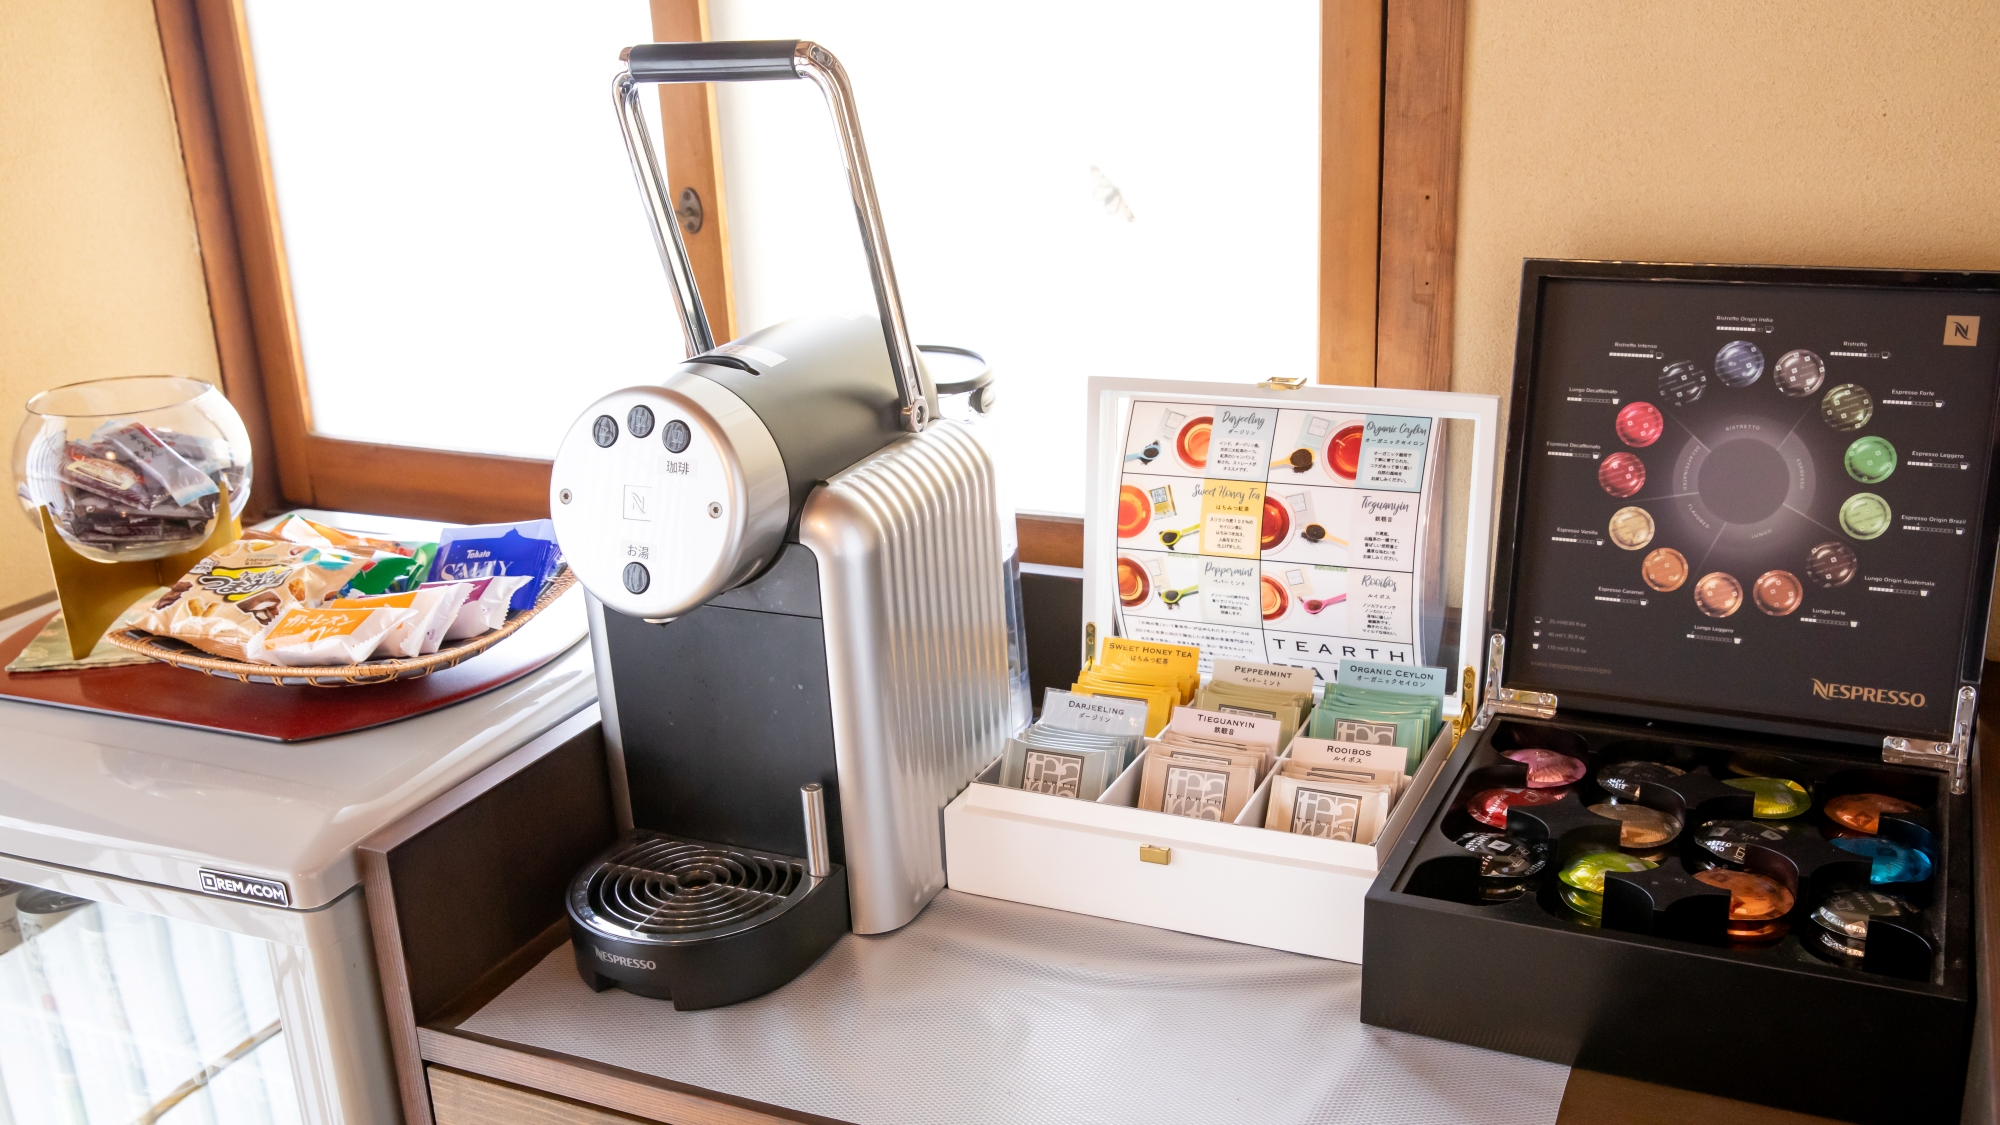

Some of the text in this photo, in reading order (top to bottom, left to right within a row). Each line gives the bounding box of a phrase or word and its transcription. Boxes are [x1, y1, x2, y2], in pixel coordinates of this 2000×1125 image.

[1221, 411, 1265, 430] Darjeeling
[1366, 421, 1427, 438] Organic Ceylon
[1365, 438, 1425, 446] オーガニックセイロン
[665, 460, 690, 476] 珈琲
[1192, 484, 1261, 504] Sweet Honey Tea
[1361, 495, 1409, 516] Tieguanyin
[1901, 514, 1928, 522] Espresso
[627, 544, 649, 560] お湯
[441, 560, 514, 580] SALTY
[1204, 561, 1254, 577] Peppermint
[1361, 574, 1397, 592] Rooibos
[1903, 578, 1935, 587] Guatemala
[1109, 642, 1192, 658] SWEET HONEY TEA
[1272, 638, 1405, 662] TEARTH
[1130, 655, 1169, 665] はちみつ紅茶
[1530, 661, 1612, 675] www.nespresso.com/pro
[1234, 665, 1293, 679] PEPPERMINT
[1349, 665, 1392, 677] ORGANIC
[1395, 669, 1434, 681] CEYLON
[1242, 676, 1282, 687] ペパーミント
[1357, 675, 1426, 687] オーガニックセイロン
[1810, 678, 1926, 707] NESPRESSO
[1068, 700, 1124, 716] DARJEELING
[1078, 712, 1111, 723] ダージリン
[1197, 713, 1255, 729] TIEGUANYIN
[1214, 726, 1235, 735] 鉄観音
[1326, 745, 1372, 756] ROOIBOS
[1333, 756, 1362, 764] ルイボス
[1167, 793, 1222, 805] TEARTH
[217, 878, 285, 901] REMACOM
[592, 944, 657, 970] NESPRESSO
